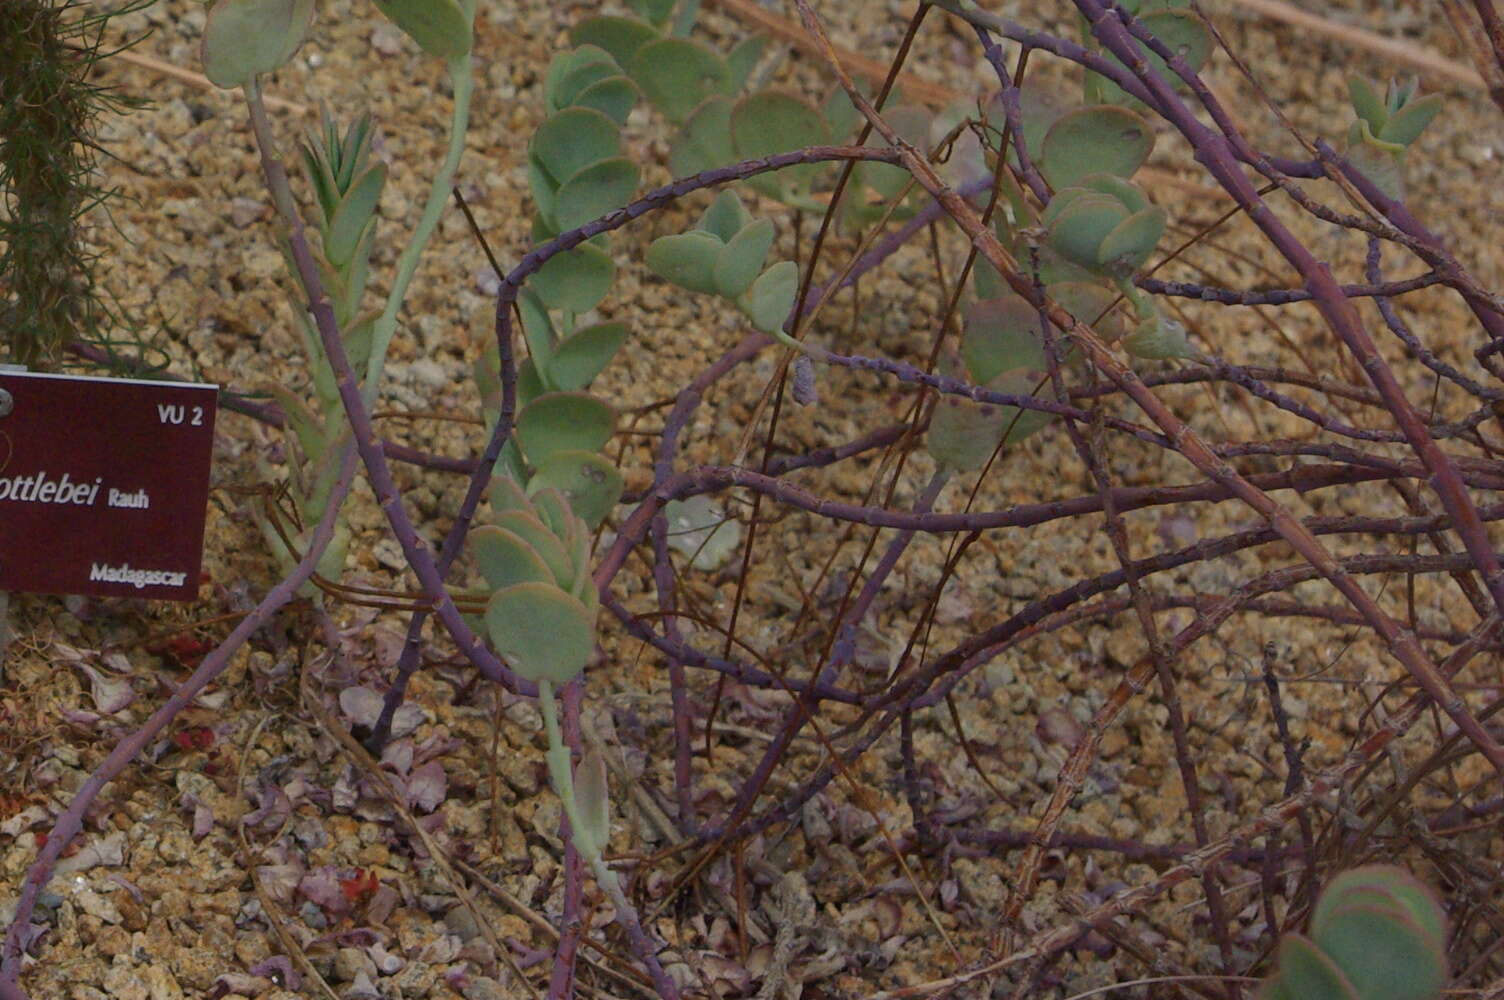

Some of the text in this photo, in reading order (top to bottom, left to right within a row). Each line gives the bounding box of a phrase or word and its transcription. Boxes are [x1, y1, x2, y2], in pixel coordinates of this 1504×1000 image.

[159, 405, 202, 425] VU 2
[109, 489, 148, 508] Rauh
[90, 564, 186, 588] Madagascar
